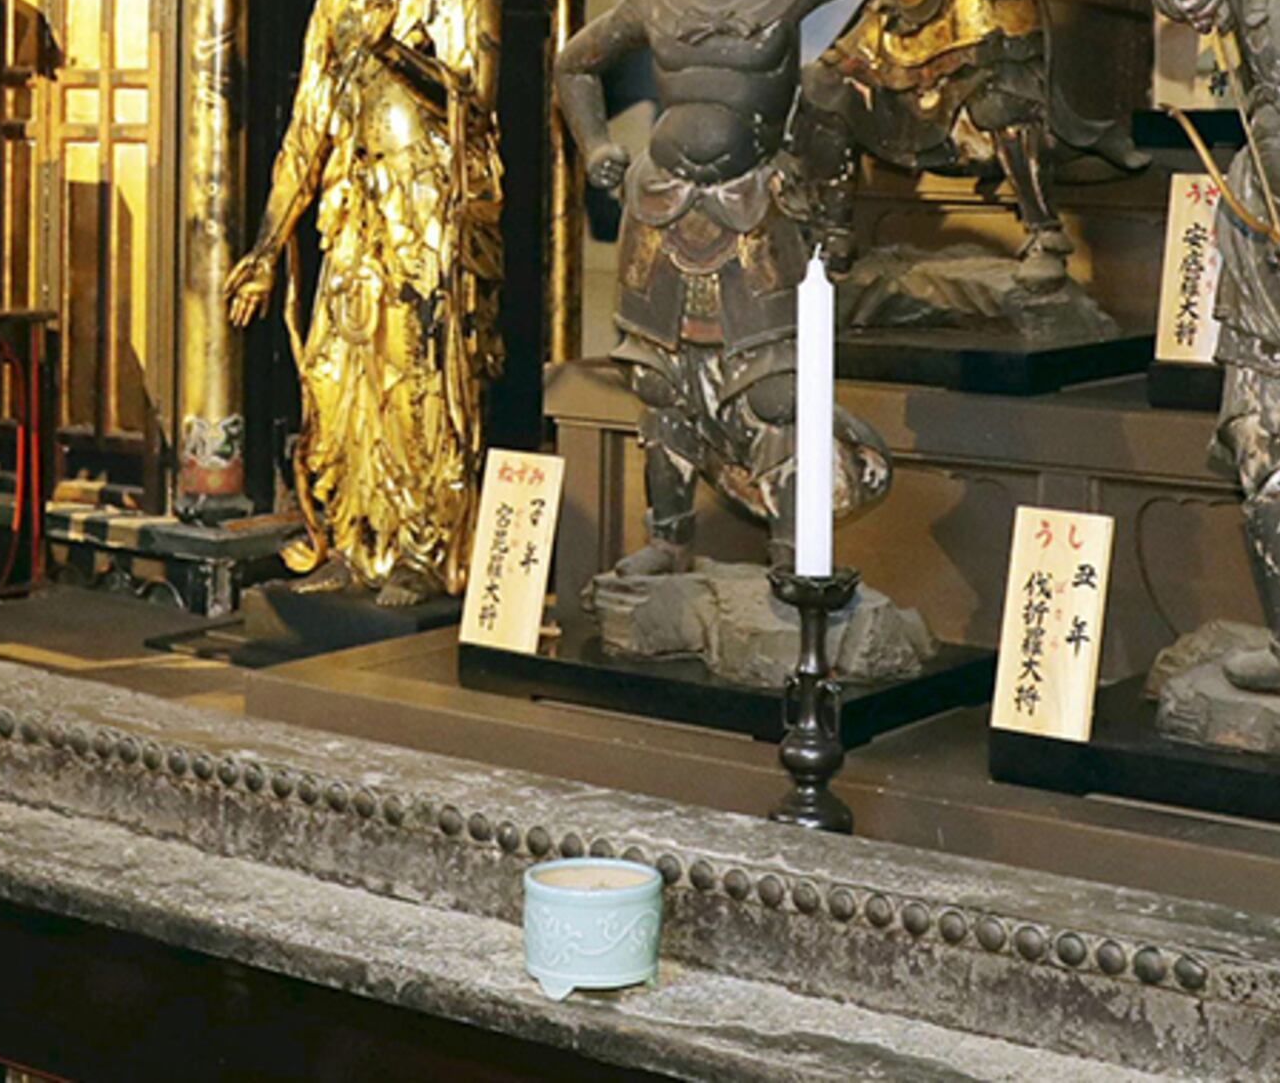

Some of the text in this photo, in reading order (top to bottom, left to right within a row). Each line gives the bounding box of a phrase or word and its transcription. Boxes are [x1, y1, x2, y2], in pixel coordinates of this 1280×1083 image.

[497, 463, 546, 486] ねずみ
[519, 497, 546, 574] 子年
[1035, 520, 1083, 550] うし
[1014, 571, 1053, 716] 伐折羅大将
[1065, 563, 1097, 658] 丑年
